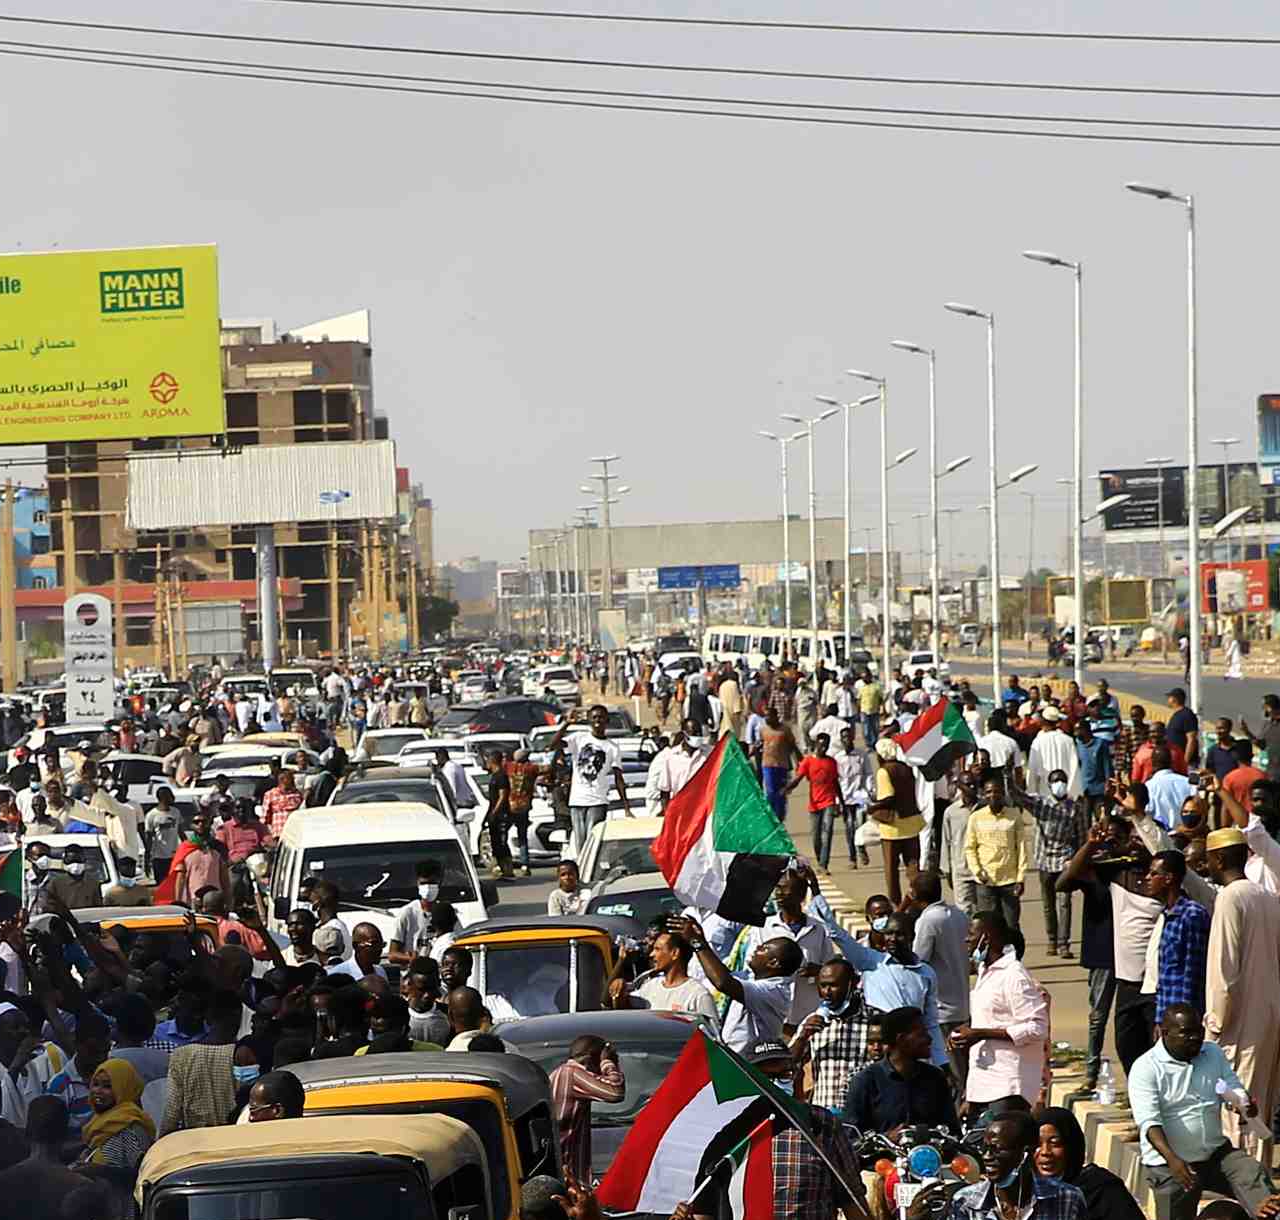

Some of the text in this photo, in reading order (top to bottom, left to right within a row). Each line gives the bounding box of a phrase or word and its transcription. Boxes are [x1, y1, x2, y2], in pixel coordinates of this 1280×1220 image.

[104, 271, 178, 289] MANN
[104, 289, 180, 309] FILTER
[143, 407, 189, 418] AROMA
